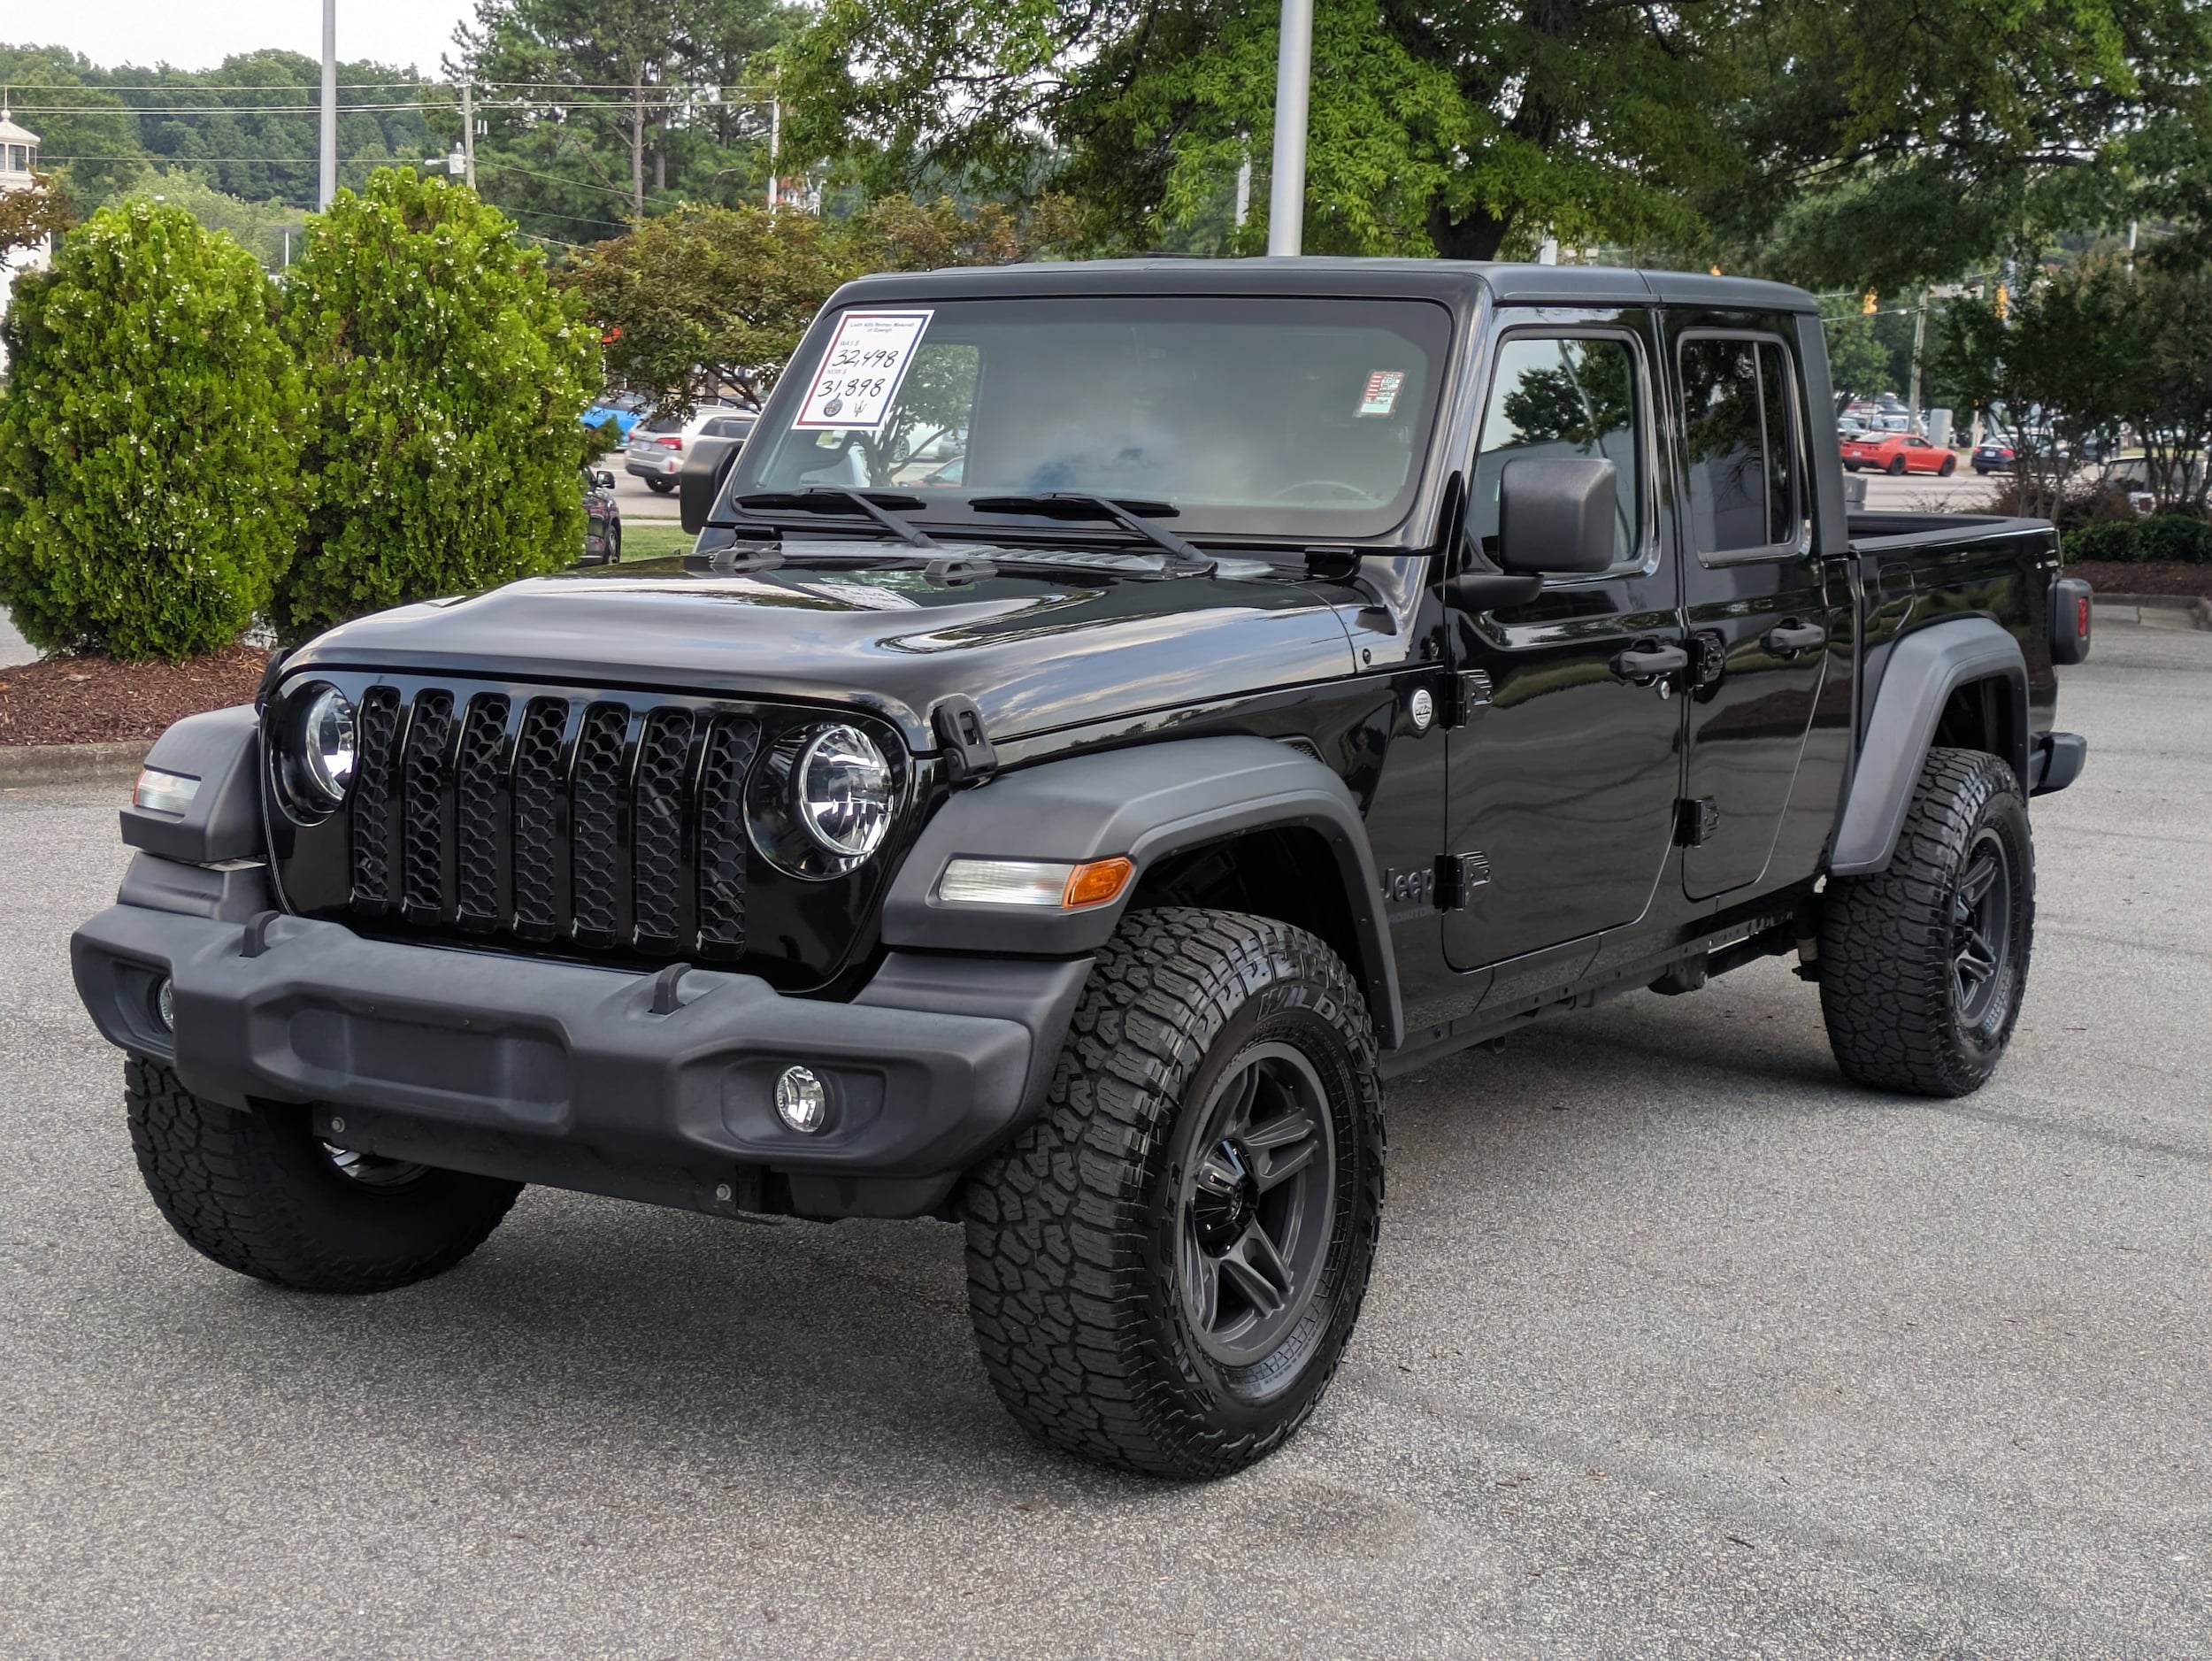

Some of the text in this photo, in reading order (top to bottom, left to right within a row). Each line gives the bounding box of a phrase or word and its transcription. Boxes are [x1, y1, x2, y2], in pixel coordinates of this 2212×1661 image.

[832, 349, 899, 368] 32,498
[818, 378, 886, 401] 31,898
[1380, 867, 1435, 904] Jeep
